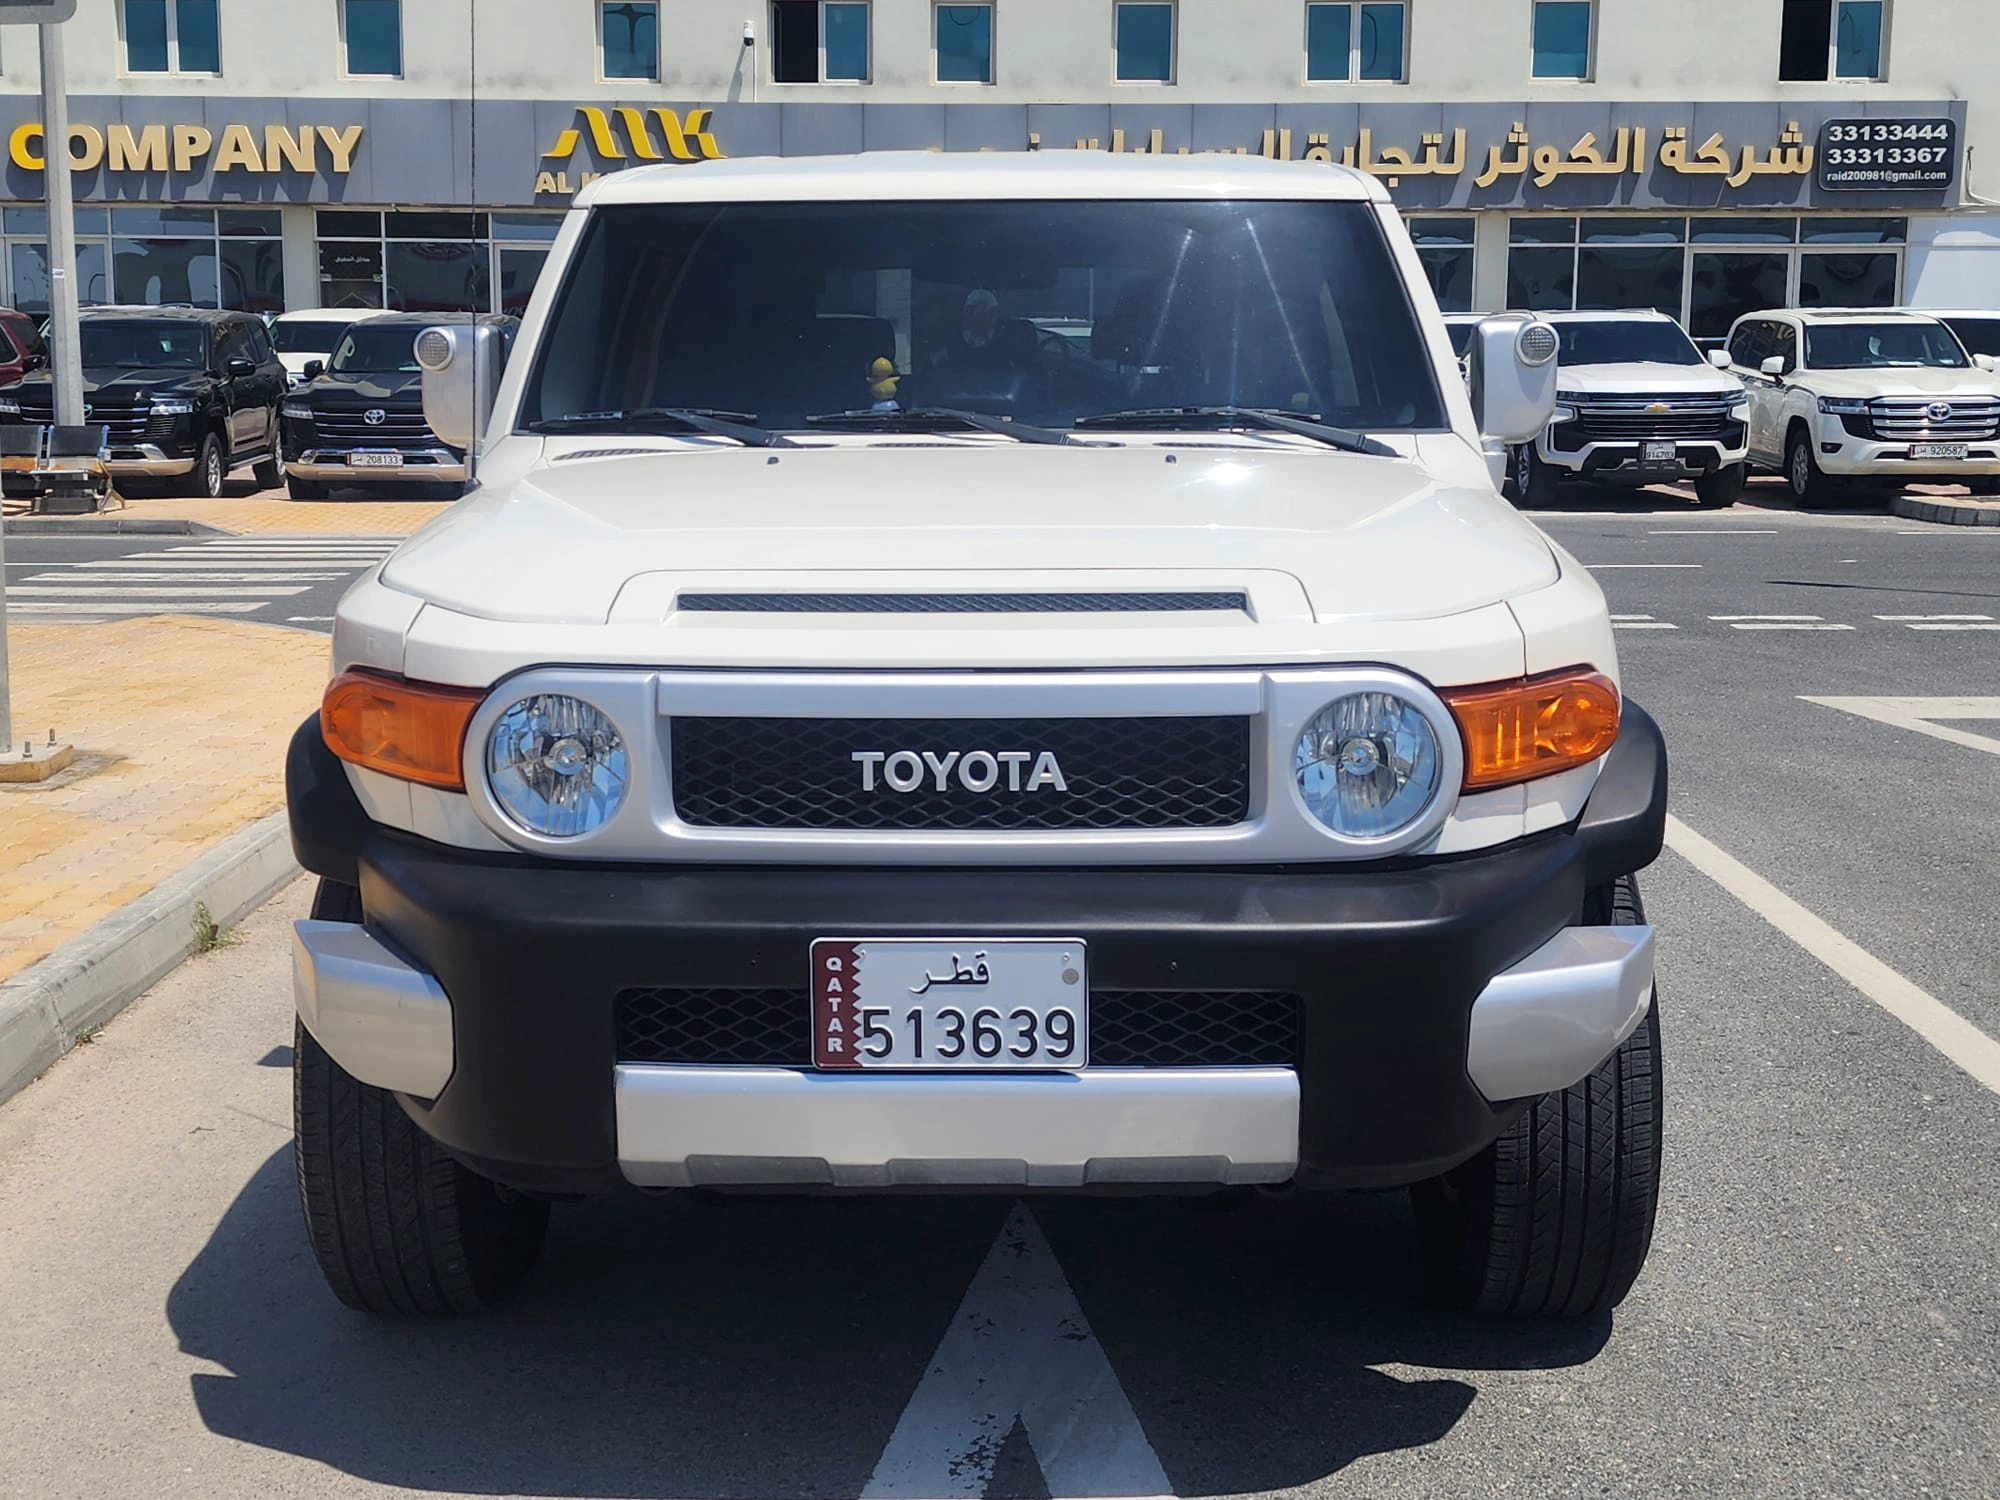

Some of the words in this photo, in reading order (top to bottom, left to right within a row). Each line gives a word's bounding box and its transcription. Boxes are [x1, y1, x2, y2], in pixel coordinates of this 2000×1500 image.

[9, 123, 364, 173] COMPANY
[1473, 121, 1646, 188] الكوثر
[1659, 121, 1814, 188] شركة
[1828, 124, 1949, 142] 33133444
[1826, 169, 1947, 183] raid200981@gmail.com
[1827, 147, 1948, 165] 33313367
[534, 171, 575, 194] AL
[851, 750, 1068, 793] TOYOTA
[908, 950, 991, 995] قطر
[825, 956, 844, 1053] QATAR
[861, 1006, 1076, 1060] 513639
